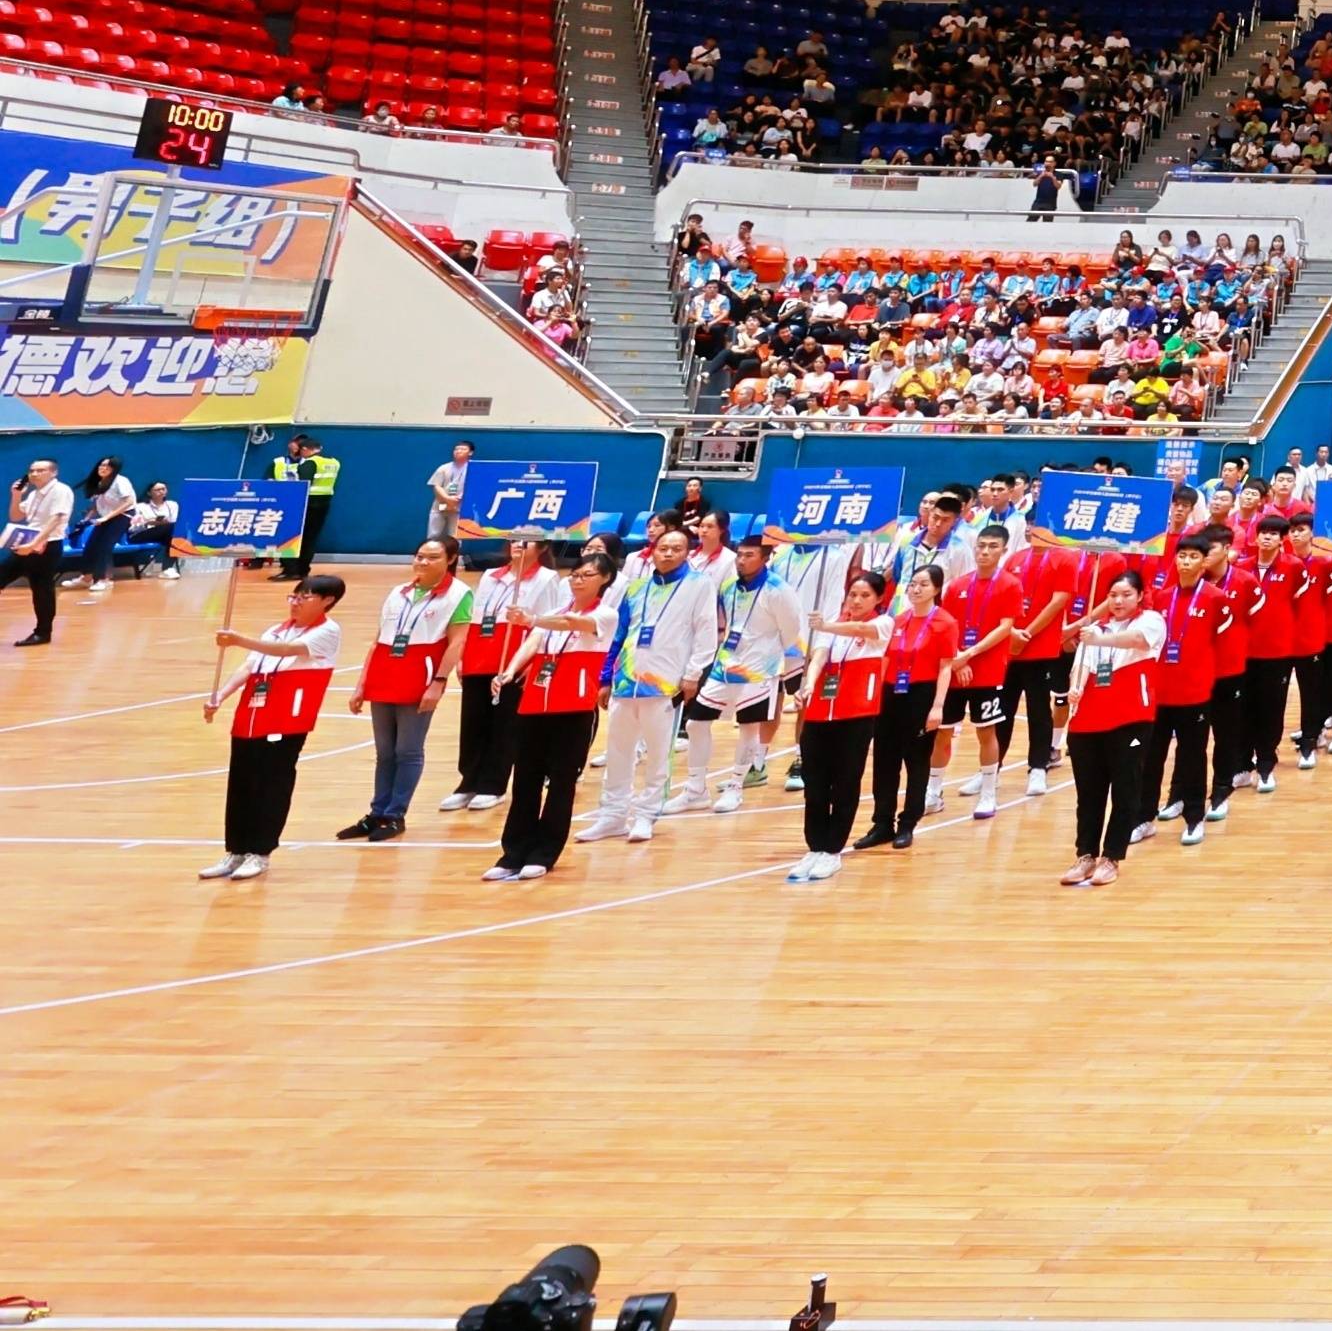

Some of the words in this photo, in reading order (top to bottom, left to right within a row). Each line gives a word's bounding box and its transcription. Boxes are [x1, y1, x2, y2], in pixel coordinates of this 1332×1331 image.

[168, 105, 224, 132] 10:00
[159, 128, 210, 164] 24
[487, 488, 567, 521] 广西
[792, 492, 873, 526] 河南
[1062, 498, 1142, 535] 福建
[199, 508, 283, 537] 志愿者
[980, 696, 1002, 720] 22
